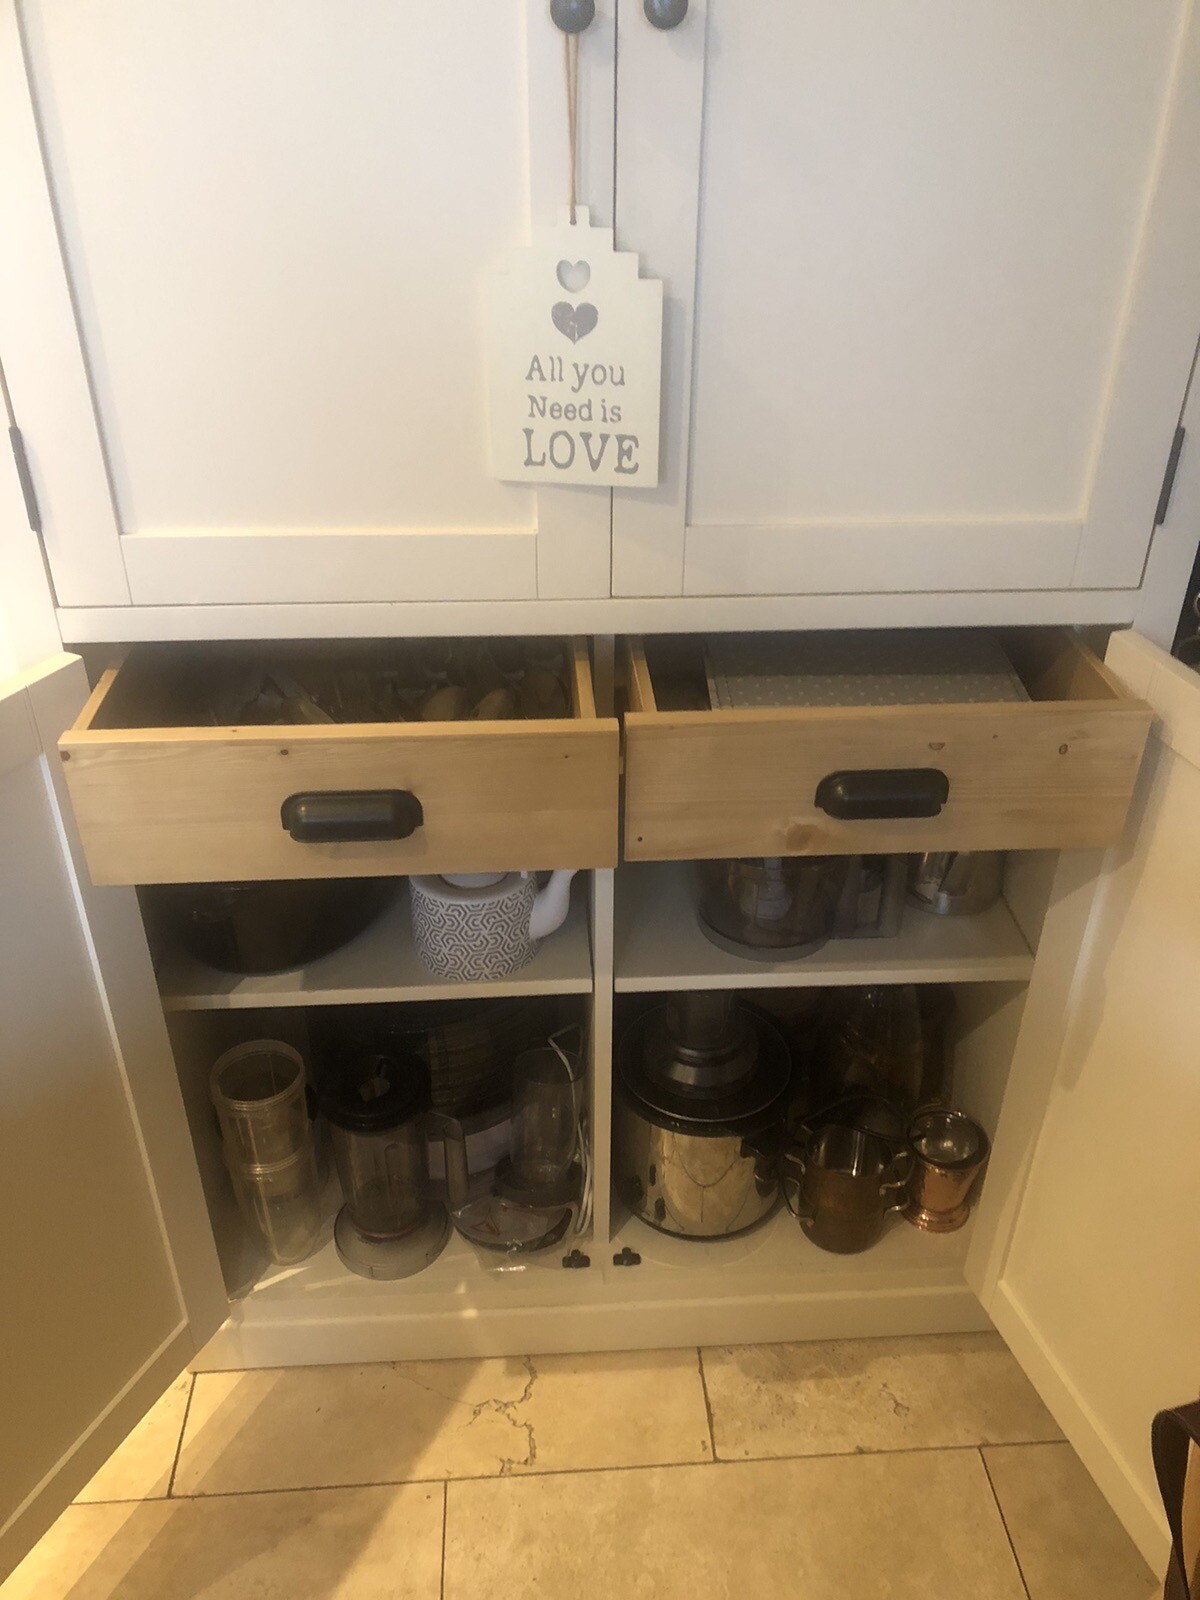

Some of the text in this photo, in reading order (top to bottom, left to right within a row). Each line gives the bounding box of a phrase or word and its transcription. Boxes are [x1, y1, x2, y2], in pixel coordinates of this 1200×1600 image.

[525, 354, 626, 394] All you
[527, 394, 622, 424] Need is
[522, 427, 640, 475] LOVE
